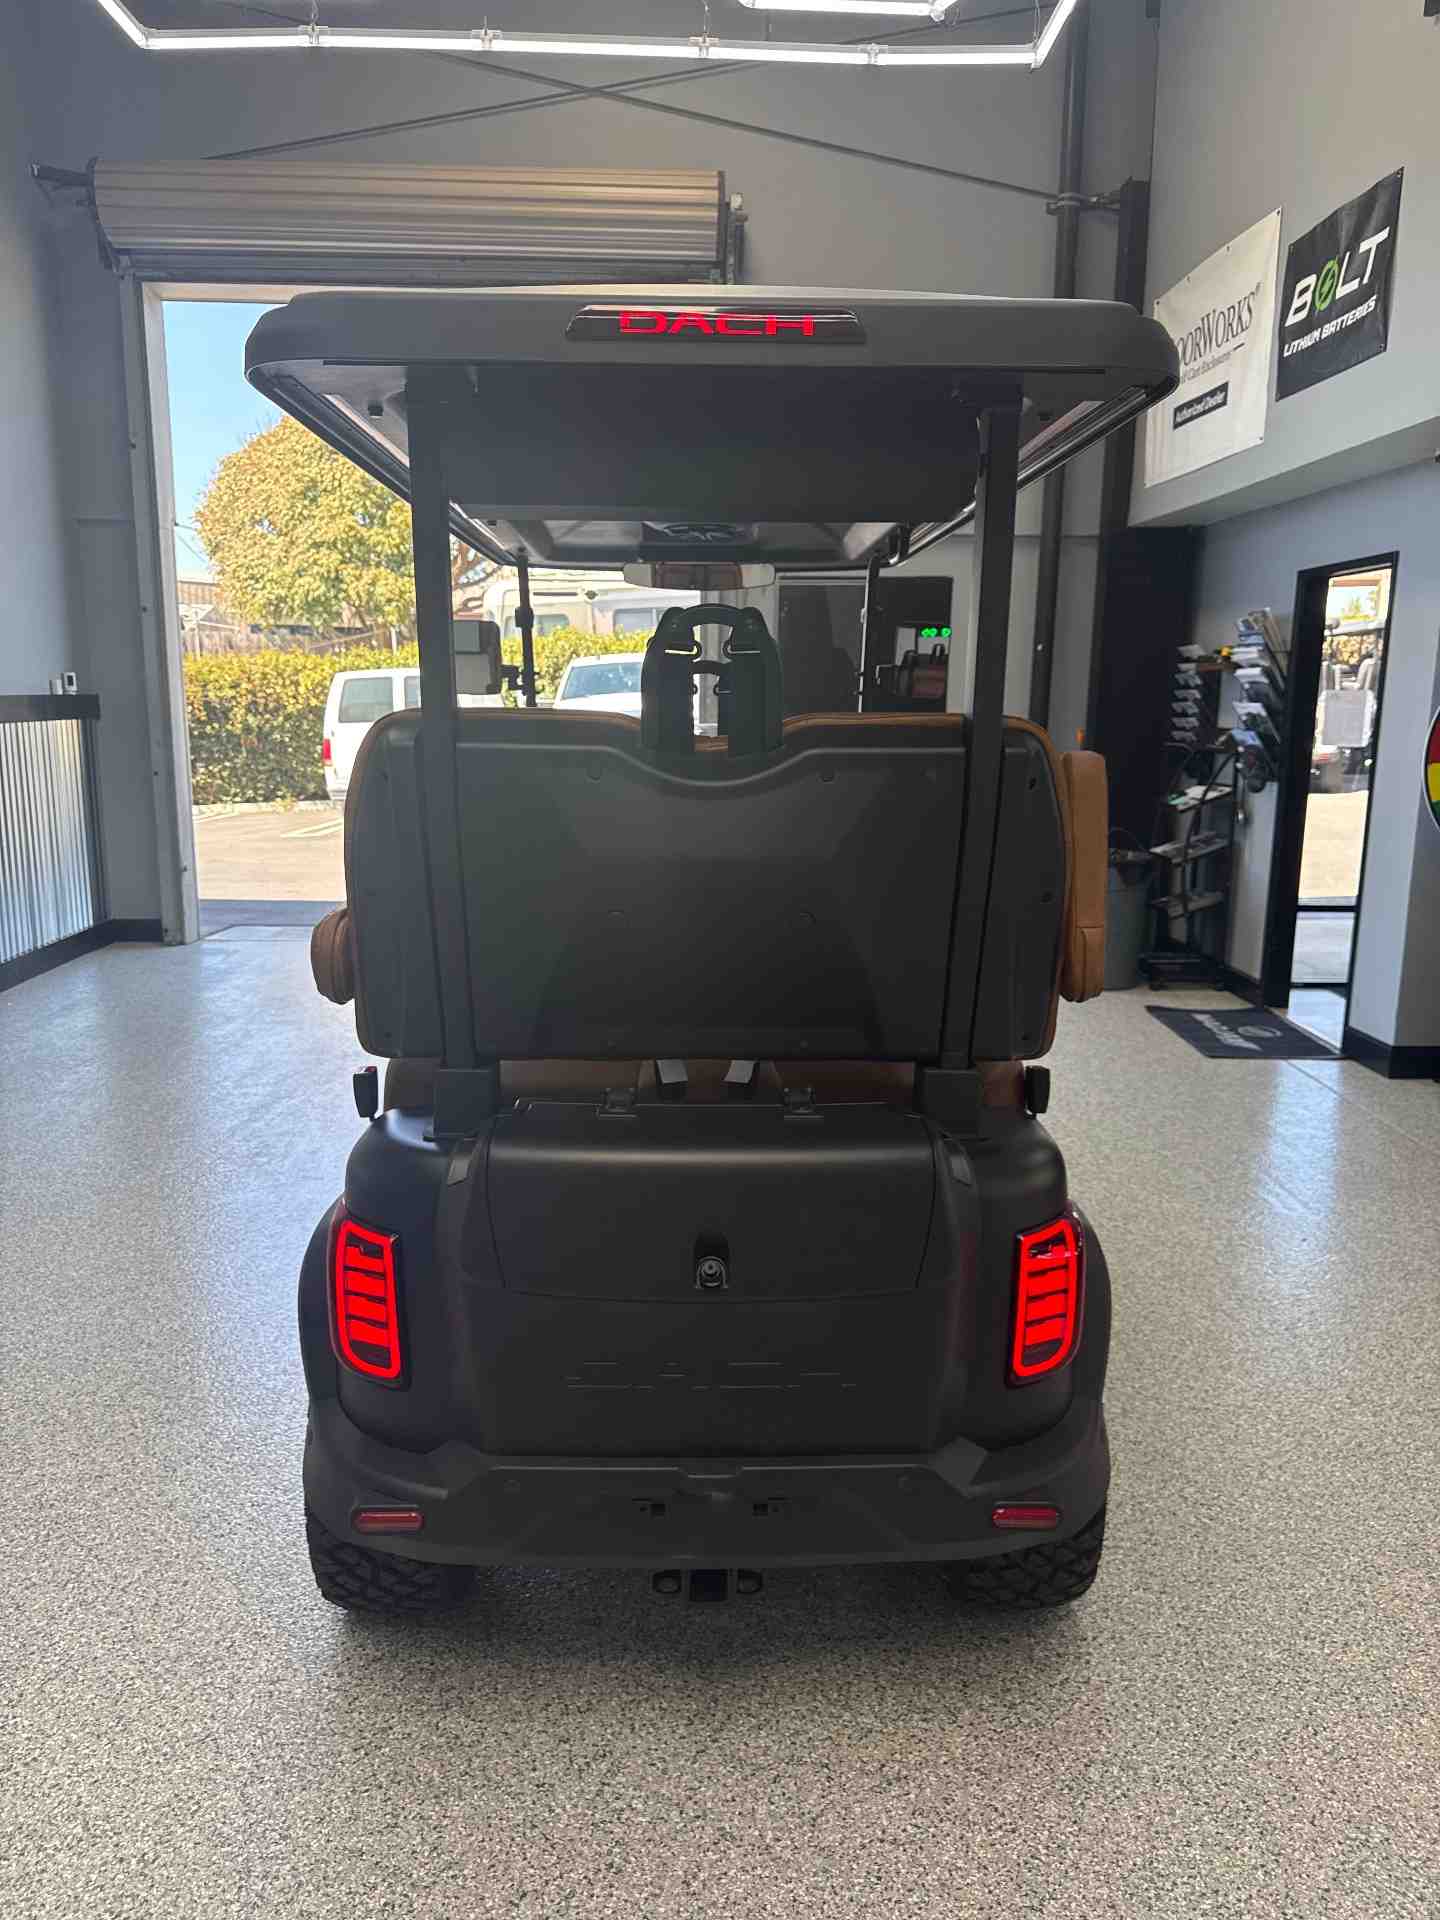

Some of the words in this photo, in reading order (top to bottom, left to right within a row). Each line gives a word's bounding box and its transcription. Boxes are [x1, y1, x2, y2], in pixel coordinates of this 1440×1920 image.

[1284, 226, 1390, 327] BOLT
[620, 310, 815, 336] DACH
[1176, 290, 1255, 366] OORWORKS
[1283, 328, 1322, 358] LITHIUM
[1321, 295, 1377, 340] BATTERIES
